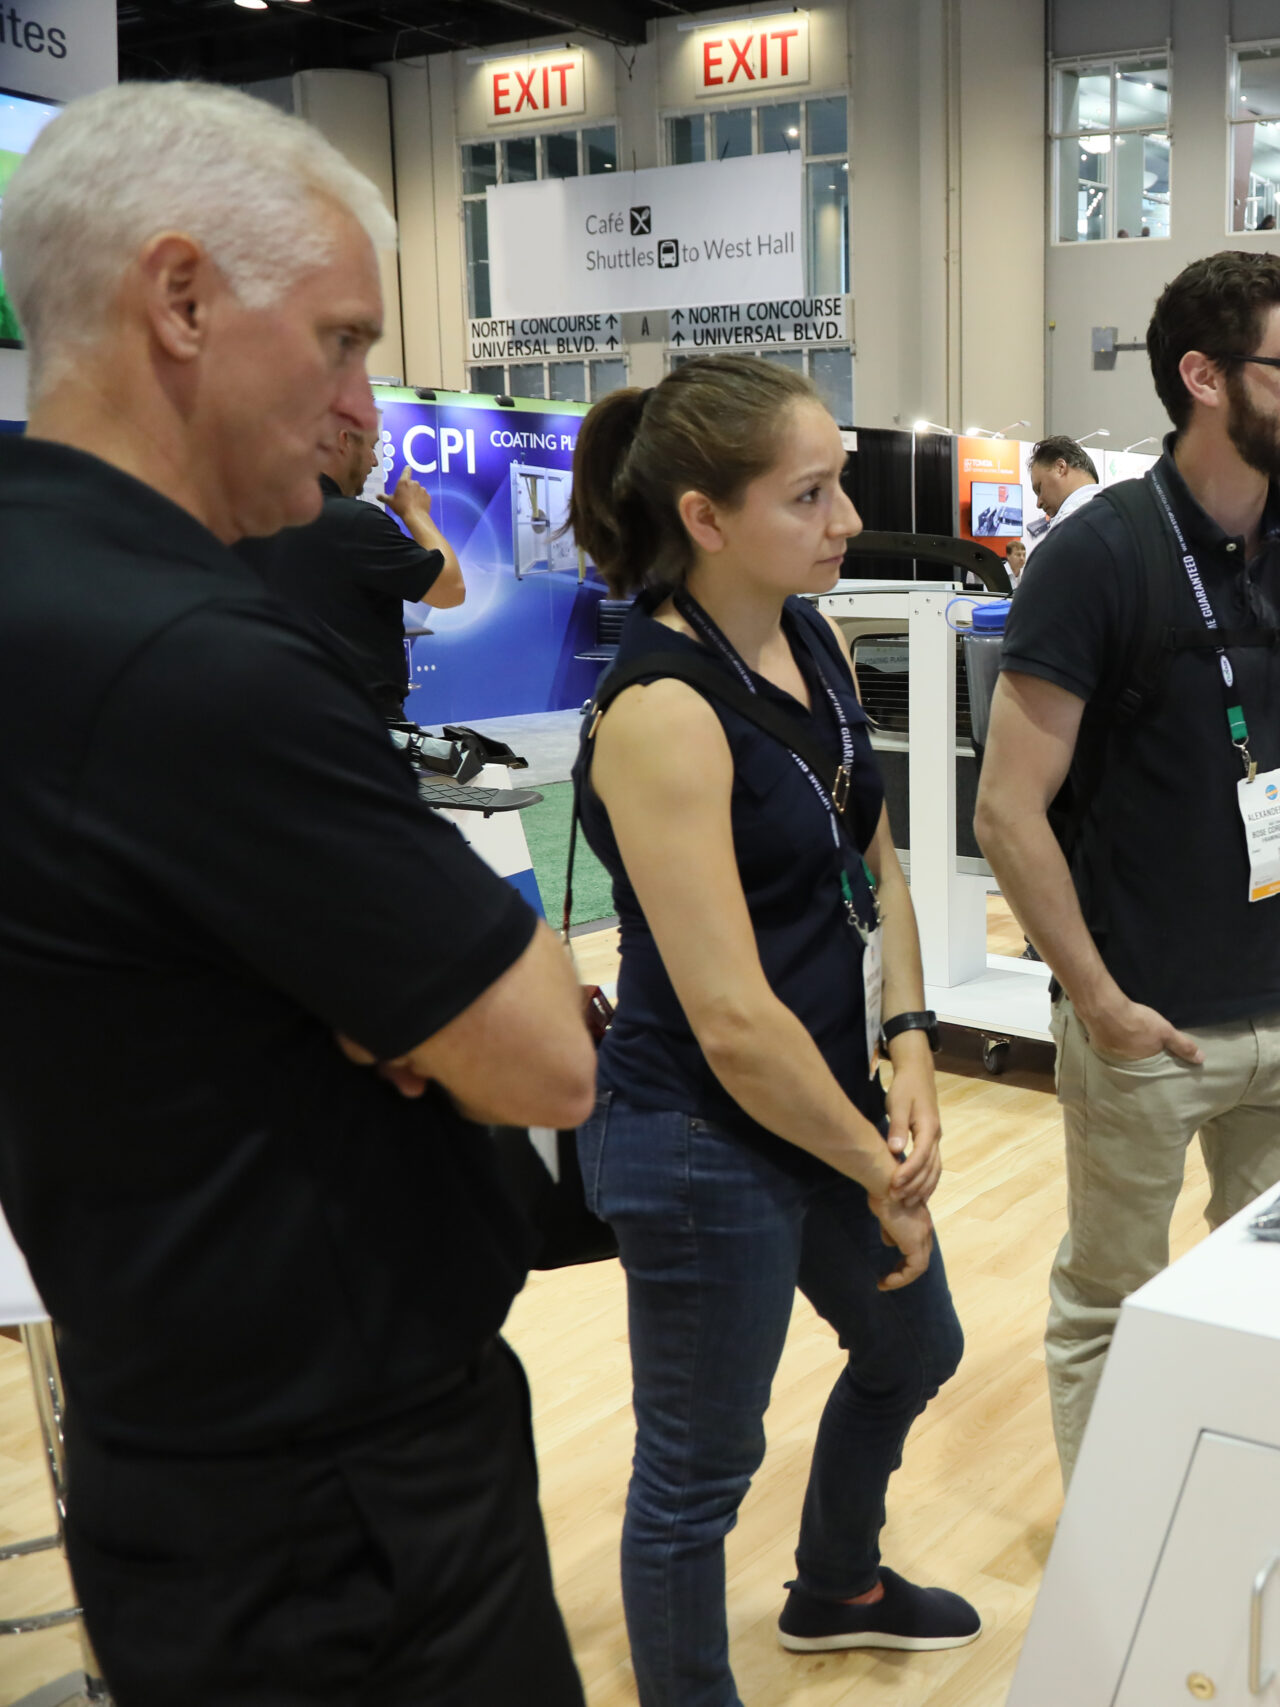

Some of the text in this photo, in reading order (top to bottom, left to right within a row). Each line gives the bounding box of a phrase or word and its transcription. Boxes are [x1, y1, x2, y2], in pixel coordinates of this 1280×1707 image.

[703, 29, 799, 87] EXIT
[492, 62, 575, 116] EXIT
[585, 212, 624, 237] Café
[585, 231, 795, 271] Shuttles to West Hall
[688, 297, 842, 325] NORTH CONCOURSE
[471, 314, 601, 338] NORTH CONCOURSE
[640, 316, 650, 337] A
[693, 320, 843, 347] UNIVERSAL BLVD.
[472, 334, 599, 358] UNIVERSAL BLVD.
[402, 424, 476, 475] CPI
[490, 430, 557, 451] COATING
[1183, 554, 1213, 618] GUARANTEED
